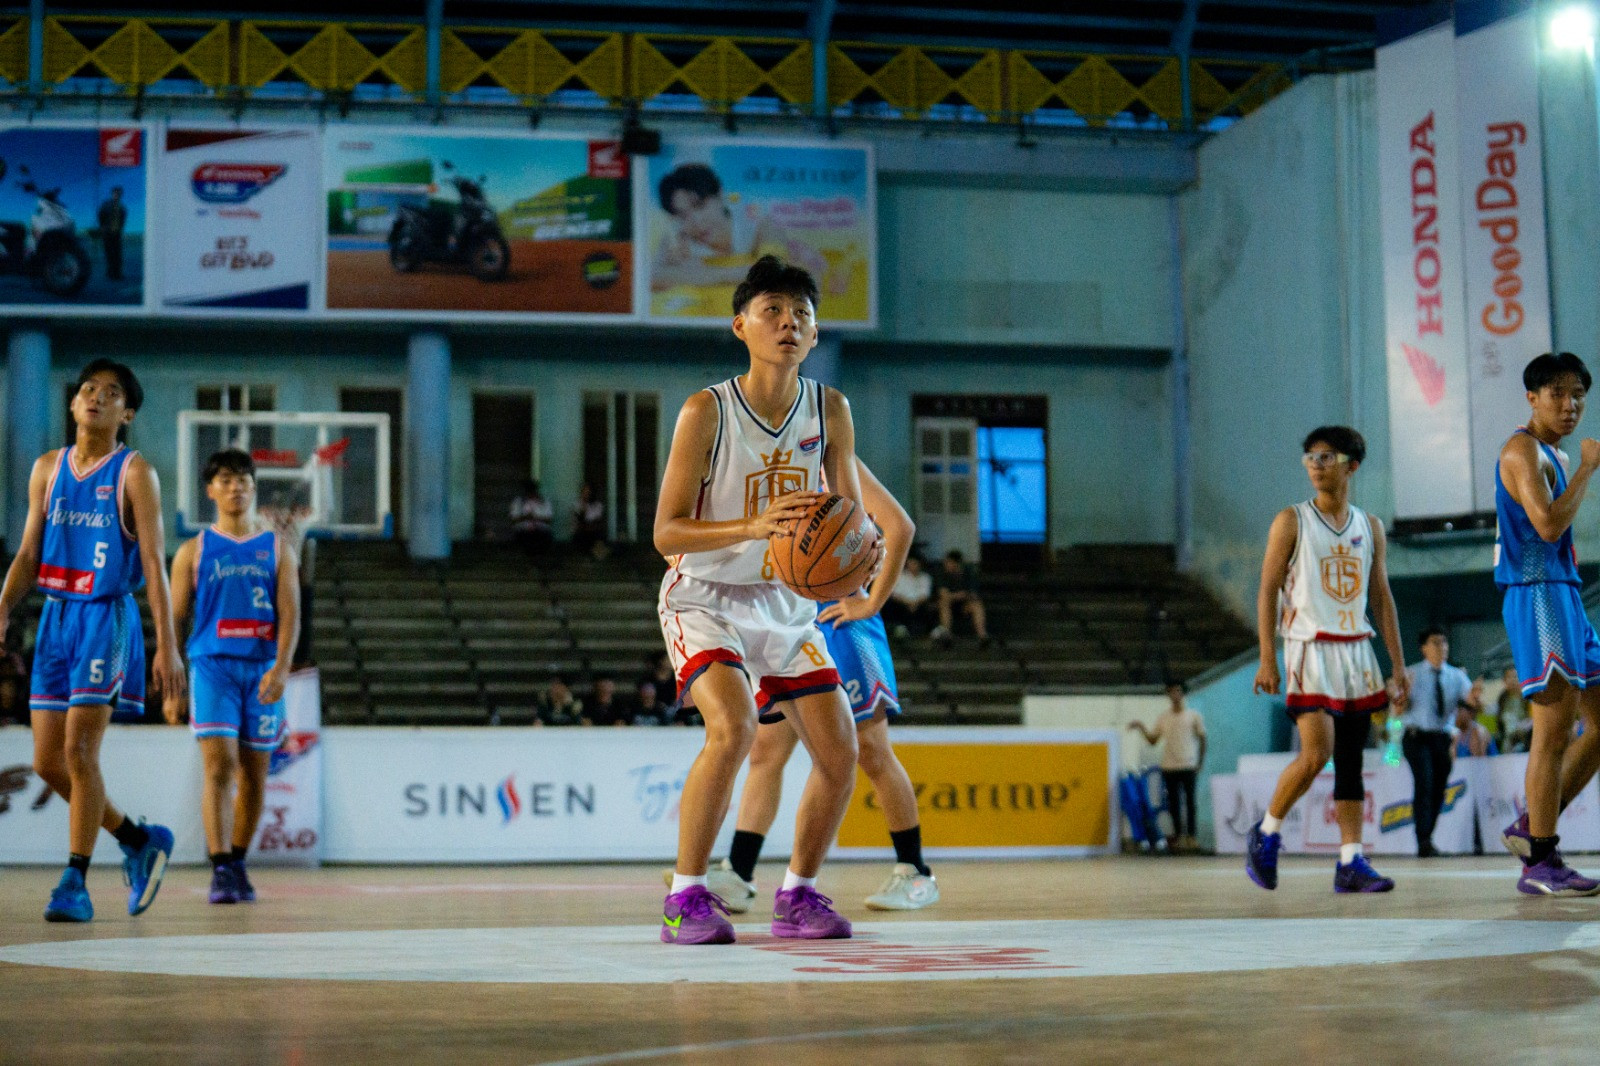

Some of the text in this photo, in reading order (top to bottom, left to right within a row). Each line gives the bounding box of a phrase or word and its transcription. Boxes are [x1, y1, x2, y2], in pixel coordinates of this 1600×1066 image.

[1410, 110, 1444, 338] HONDA
[93, 541, 109, 569] 5
[252, 586, 274, 610] 2
[1338, 609, 1356, 632] 21
[801, 641, 827, 667] 8
[89, 658, 105, 684] 5
